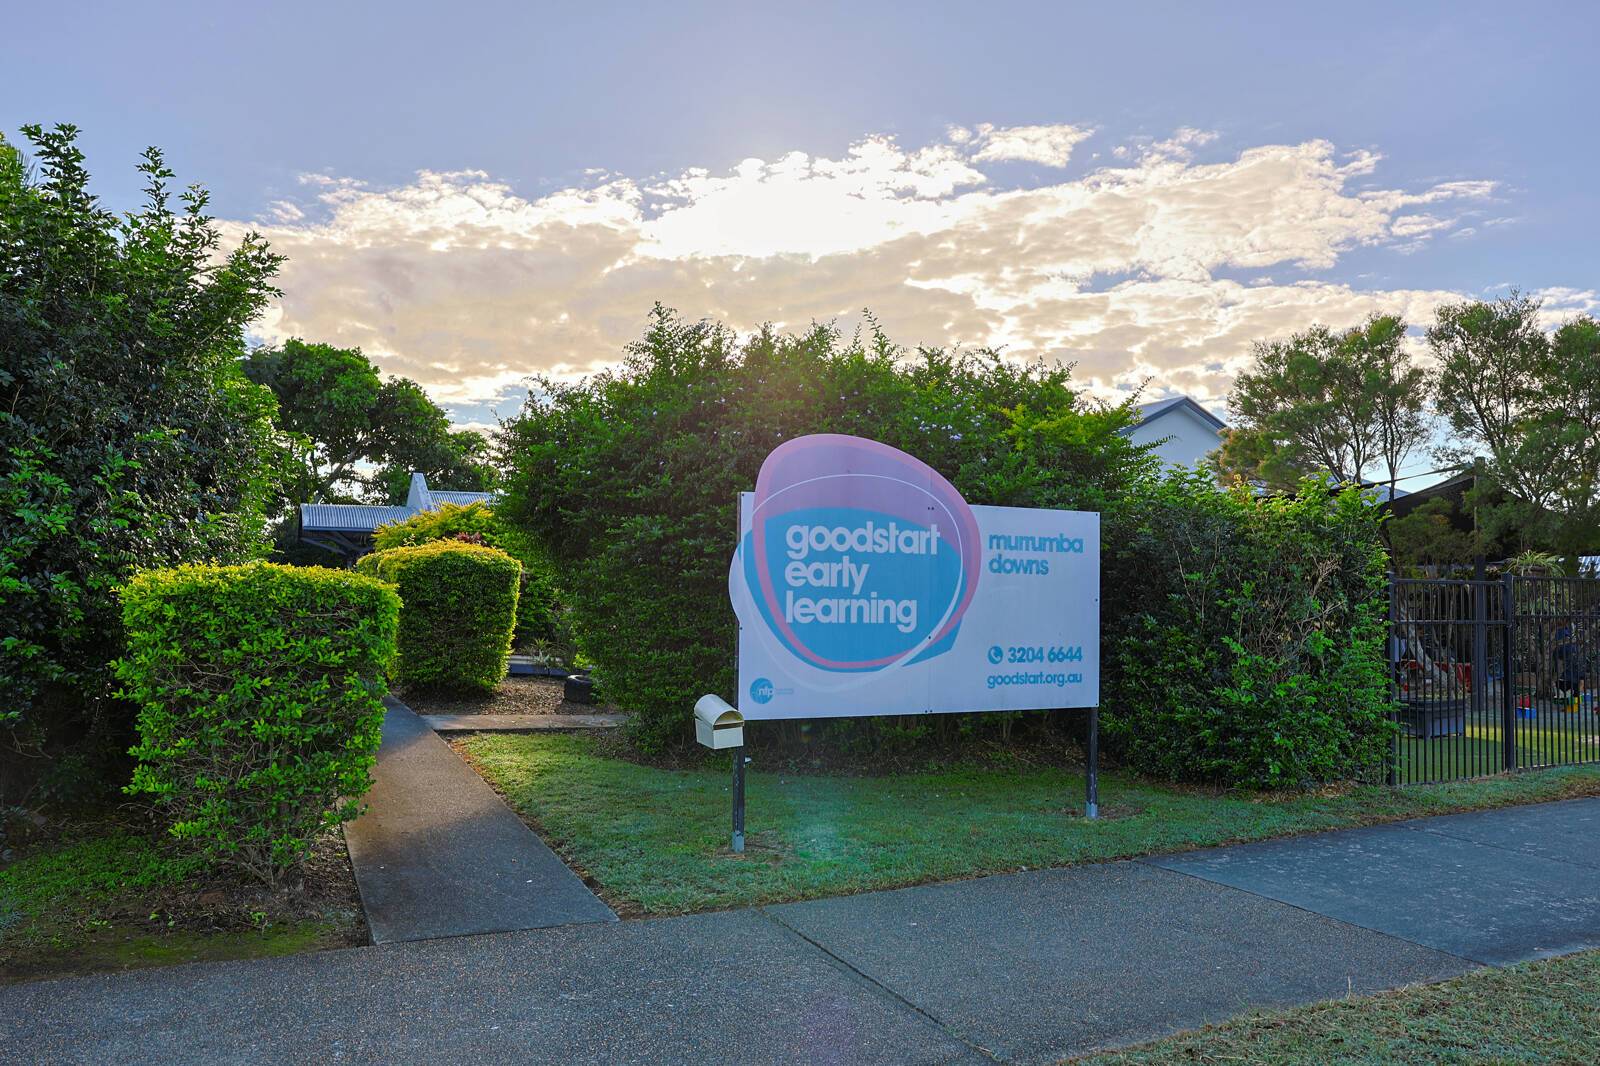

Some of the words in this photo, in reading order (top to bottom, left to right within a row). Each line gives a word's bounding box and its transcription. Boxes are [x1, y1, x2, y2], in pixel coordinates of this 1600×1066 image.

[785, 520, 941, 560] goodstart
[988, 533, 1084, 553] murrumba
[784, 555, 869, 595] early
[988, 553, 1049, 575] downs
[785, 591, 917, 633] learning
[1007, 646, 1044, 663] 3204
[1047, 646, 1083, 663] 6644
[986, 671, 1083, 689] goodstart.org.au
